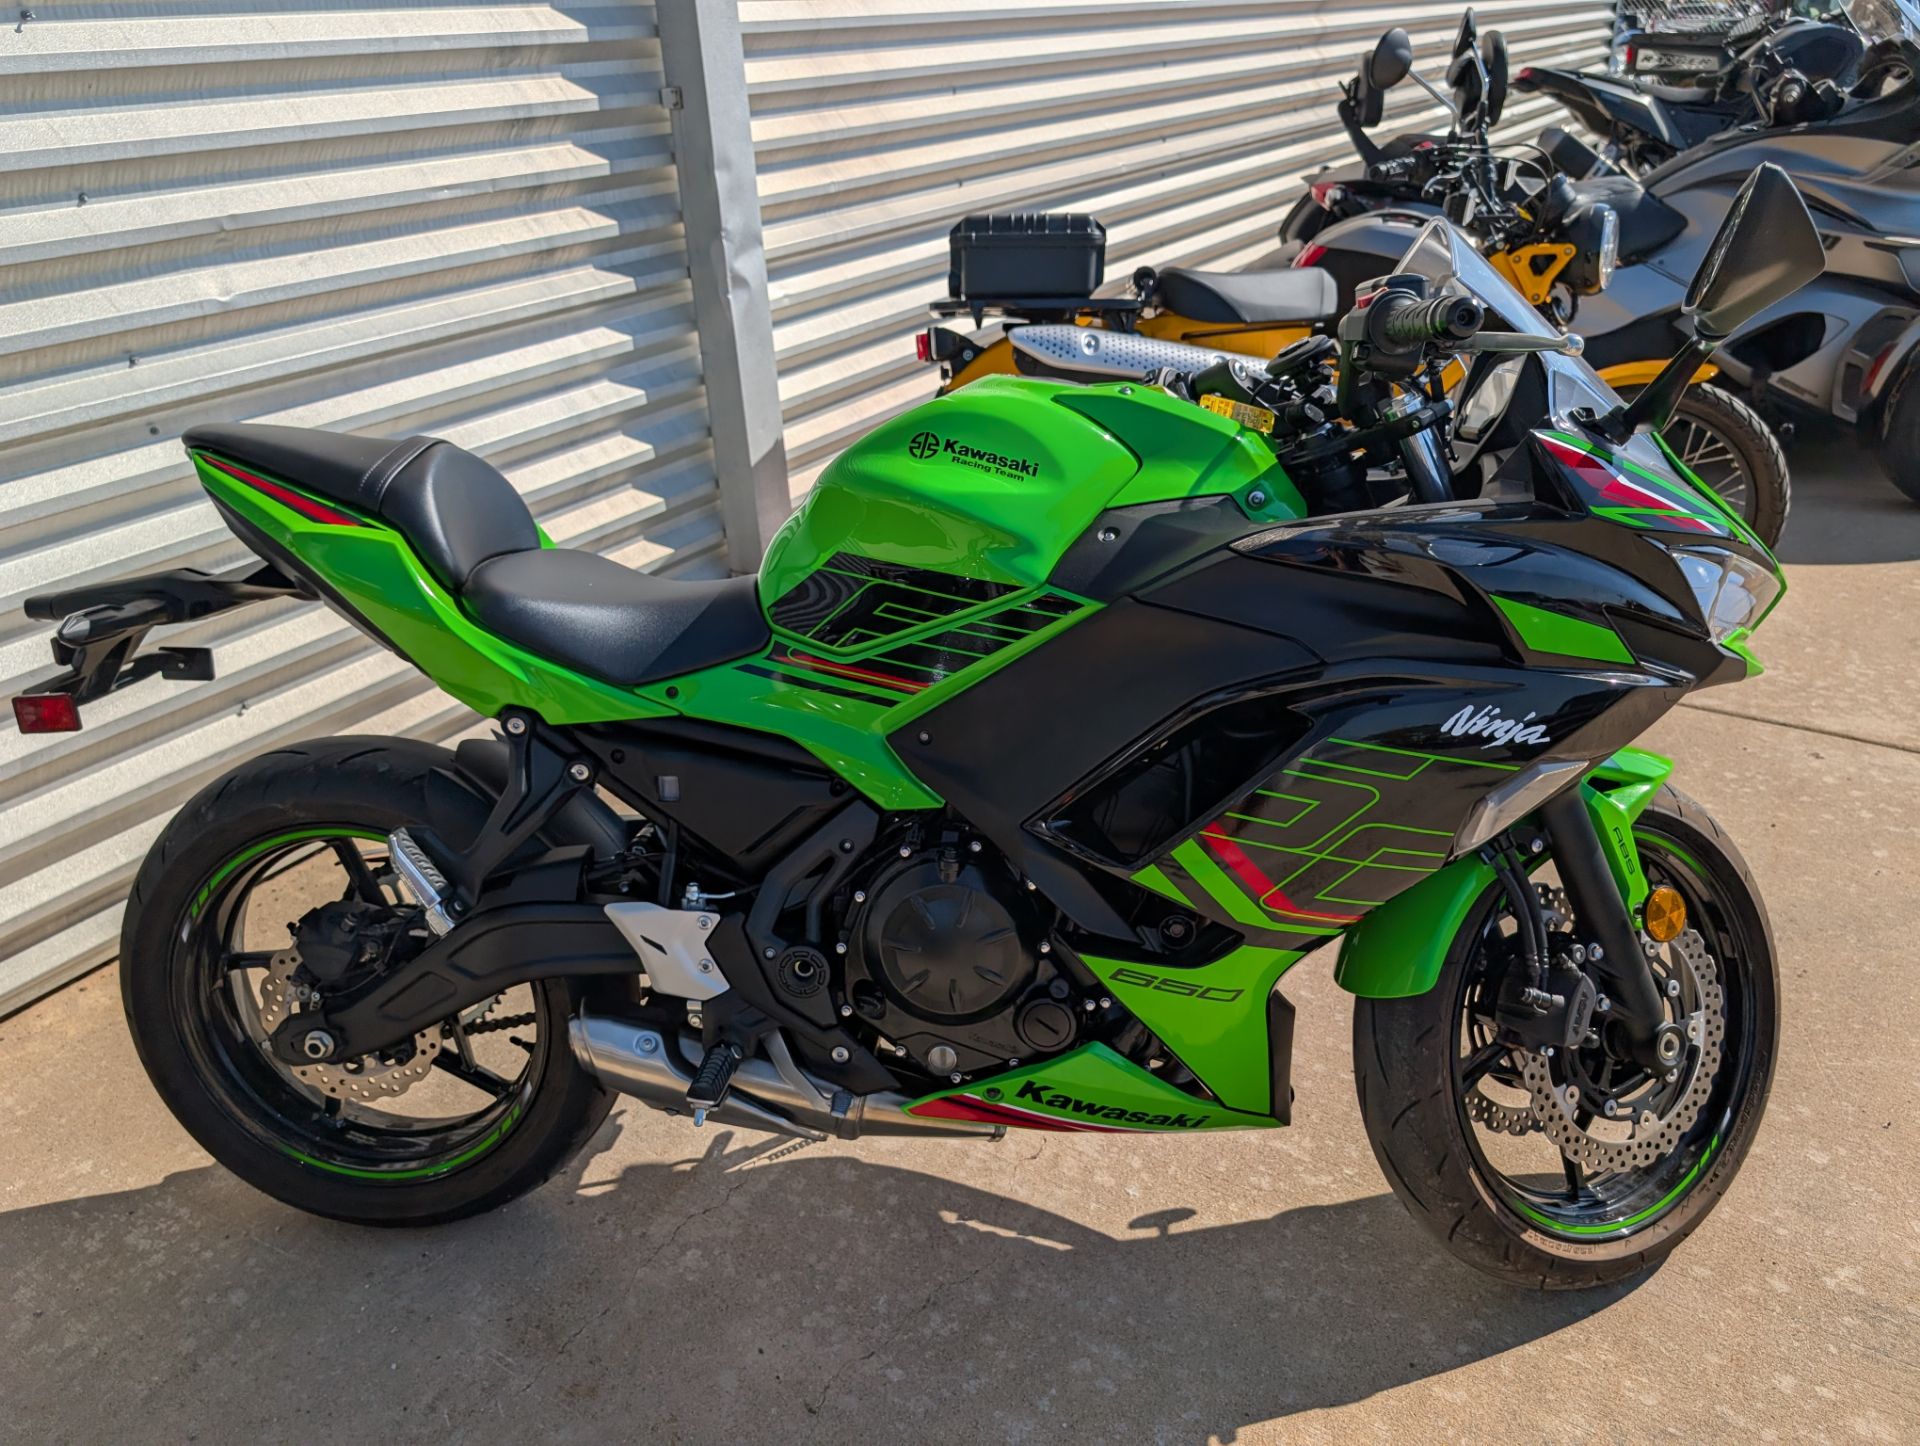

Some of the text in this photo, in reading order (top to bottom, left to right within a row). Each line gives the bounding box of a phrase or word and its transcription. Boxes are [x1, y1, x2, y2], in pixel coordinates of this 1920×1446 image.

[943, 438, 1040, 477] Kawasaki
[951, 455, 1025, 482] Racing Team
[1440, 704, 1551, 750] Ninja
[1612, 826, 1636, 875] ABS
[1108, 967, 1245, 1003] 650
[1015, 1079, 1211, 1129] Kawasaki
